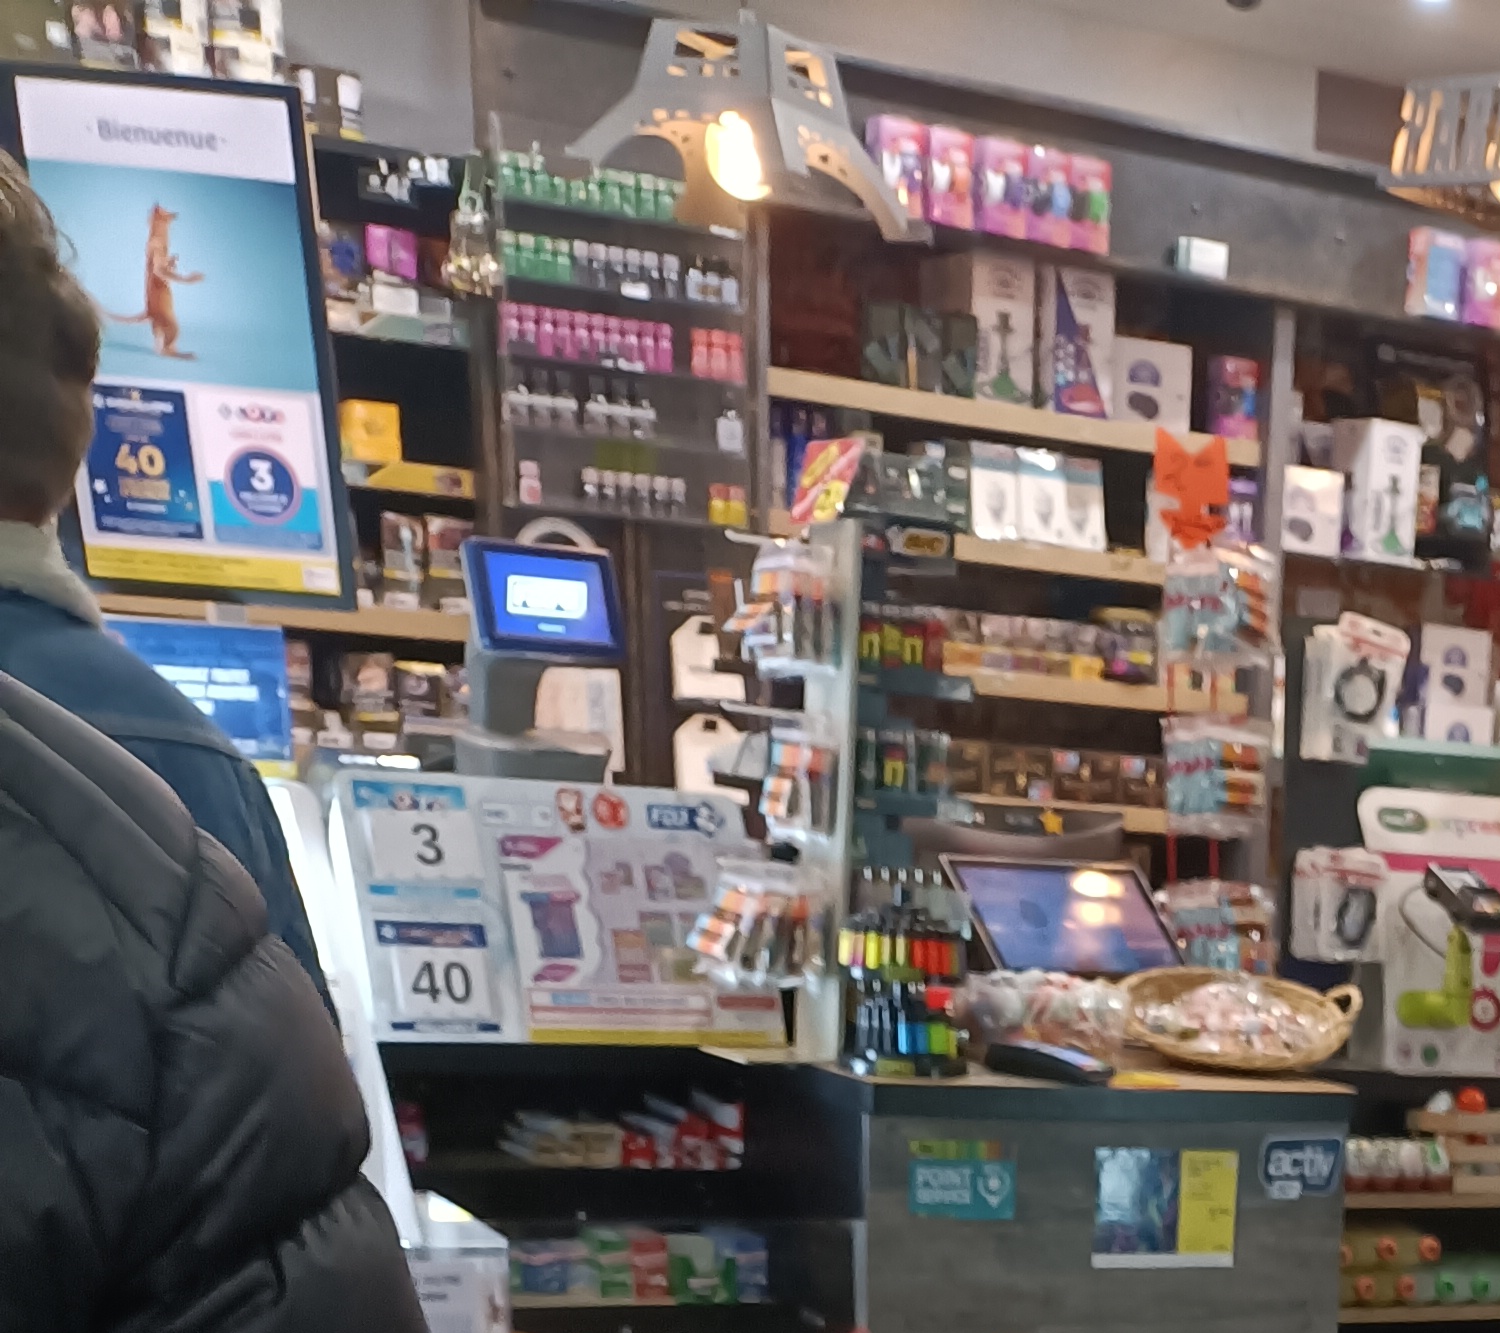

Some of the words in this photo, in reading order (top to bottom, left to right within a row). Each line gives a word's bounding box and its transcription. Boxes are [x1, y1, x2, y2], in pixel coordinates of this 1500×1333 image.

[115, 443, 165, 477] 40
[249, 458, 275, 493] 3
[412, 823, 445, 866] 3
[411, 960, 473, 1004] 40
